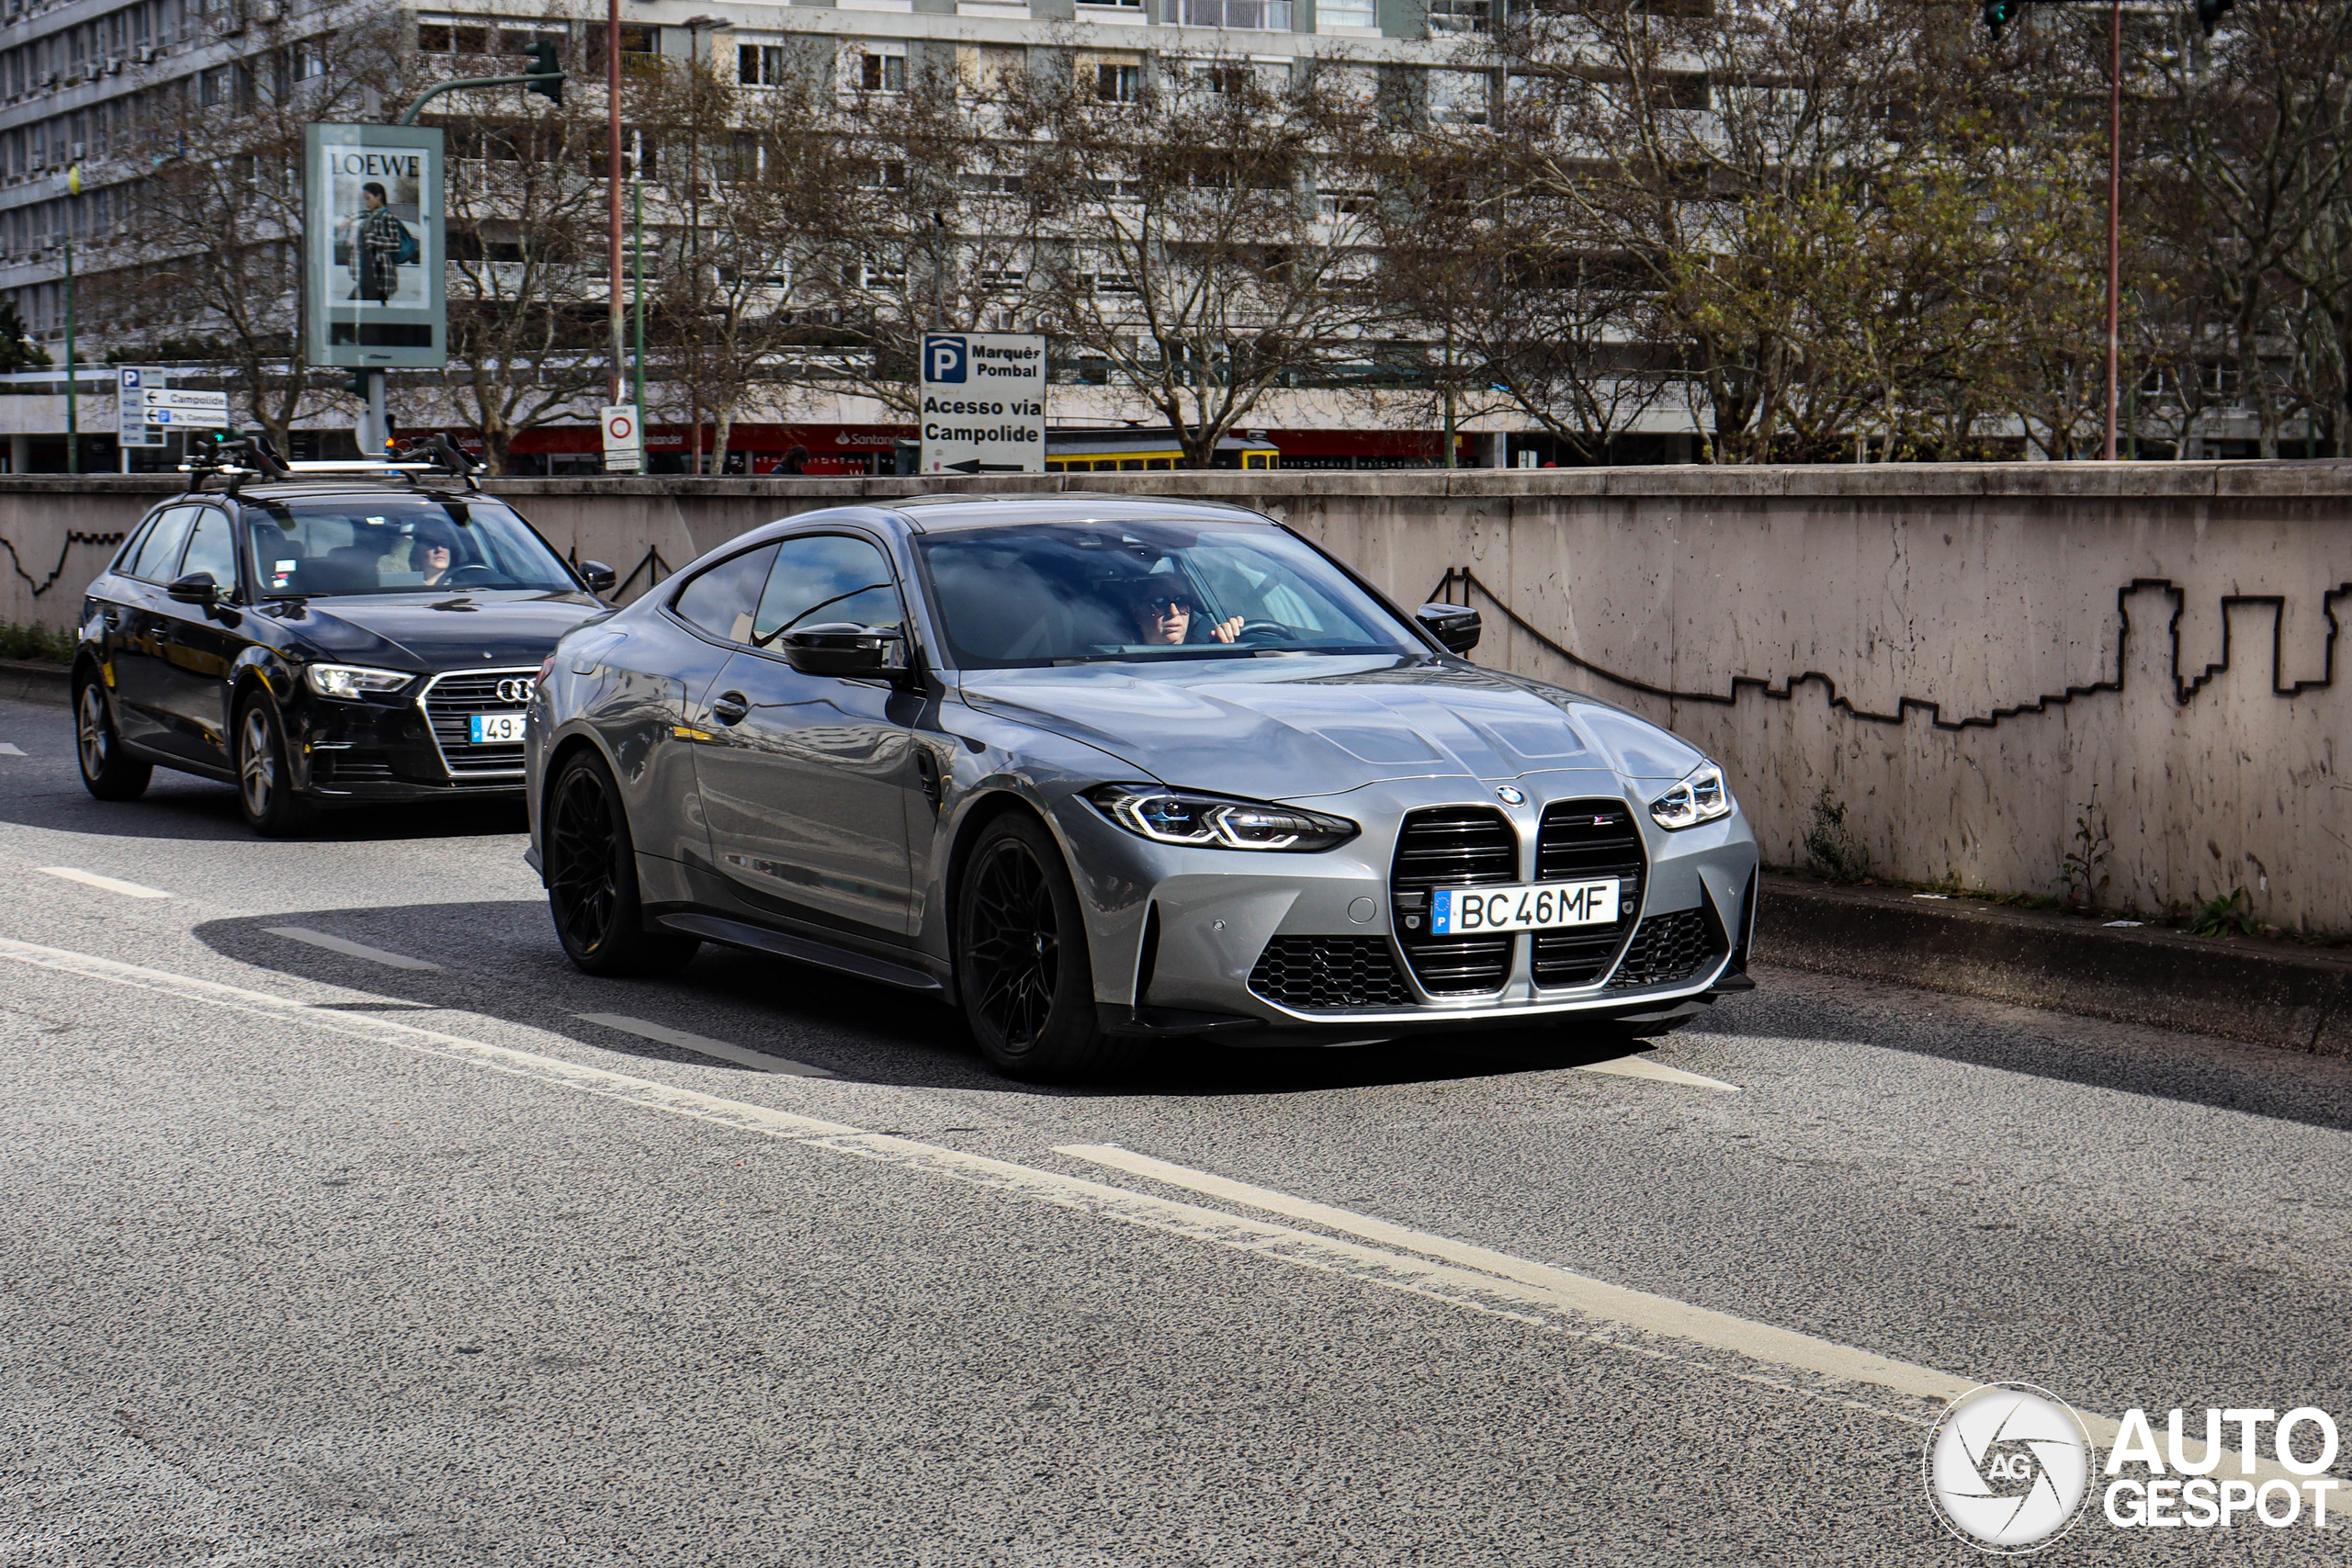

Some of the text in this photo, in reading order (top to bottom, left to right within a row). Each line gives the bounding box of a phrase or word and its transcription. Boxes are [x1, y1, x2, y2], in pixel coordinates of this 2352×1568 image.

[331, 153, 419, 176] LOEWE
[972, 345, 1041, 362] Marquês
[934, 348, 957, 379] P
[978, 363, 1037, 378] Pombal
[124, 370, 137, 386] P
[170, 393, 224, 405] Campolide
[923, 396, 1042, 415] Acesso via
[925, 423, 1039, 445] Campolide
[1437, 917, 1446, 927] P
